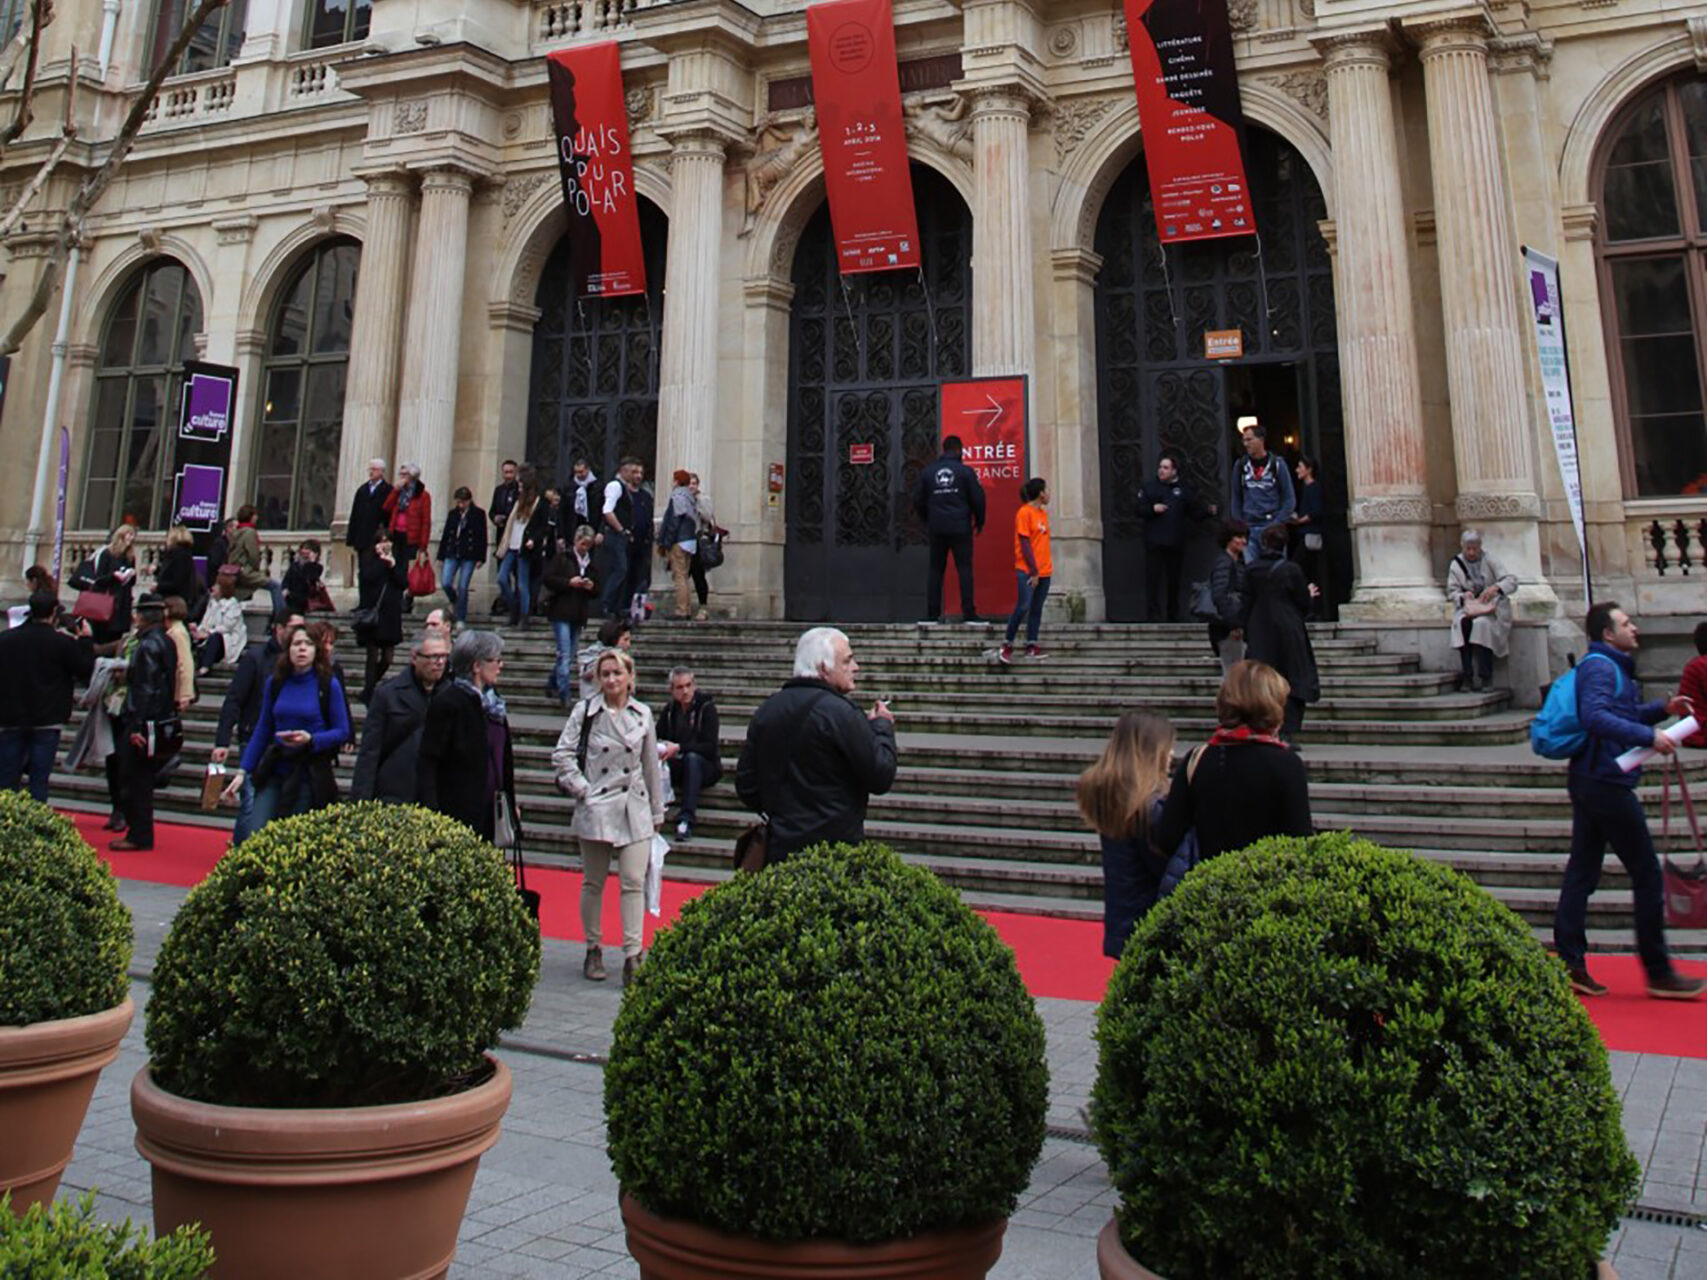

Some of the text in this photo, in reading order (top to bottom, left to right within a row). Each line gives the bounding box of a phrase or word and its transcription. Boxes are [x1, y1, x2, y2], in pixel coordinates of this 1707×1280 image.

[1168, 54, 1196, 64] CINÉMA
[561, 123, 621, 164] QUAIS
[576, 161, 604, 181] DU
[568, 170, 626, 216] POLAR
[191, 415, 226, 429] culture
[961, 441, 1017, 459] NTRÉE
[180, 504, 217, 518] culture
